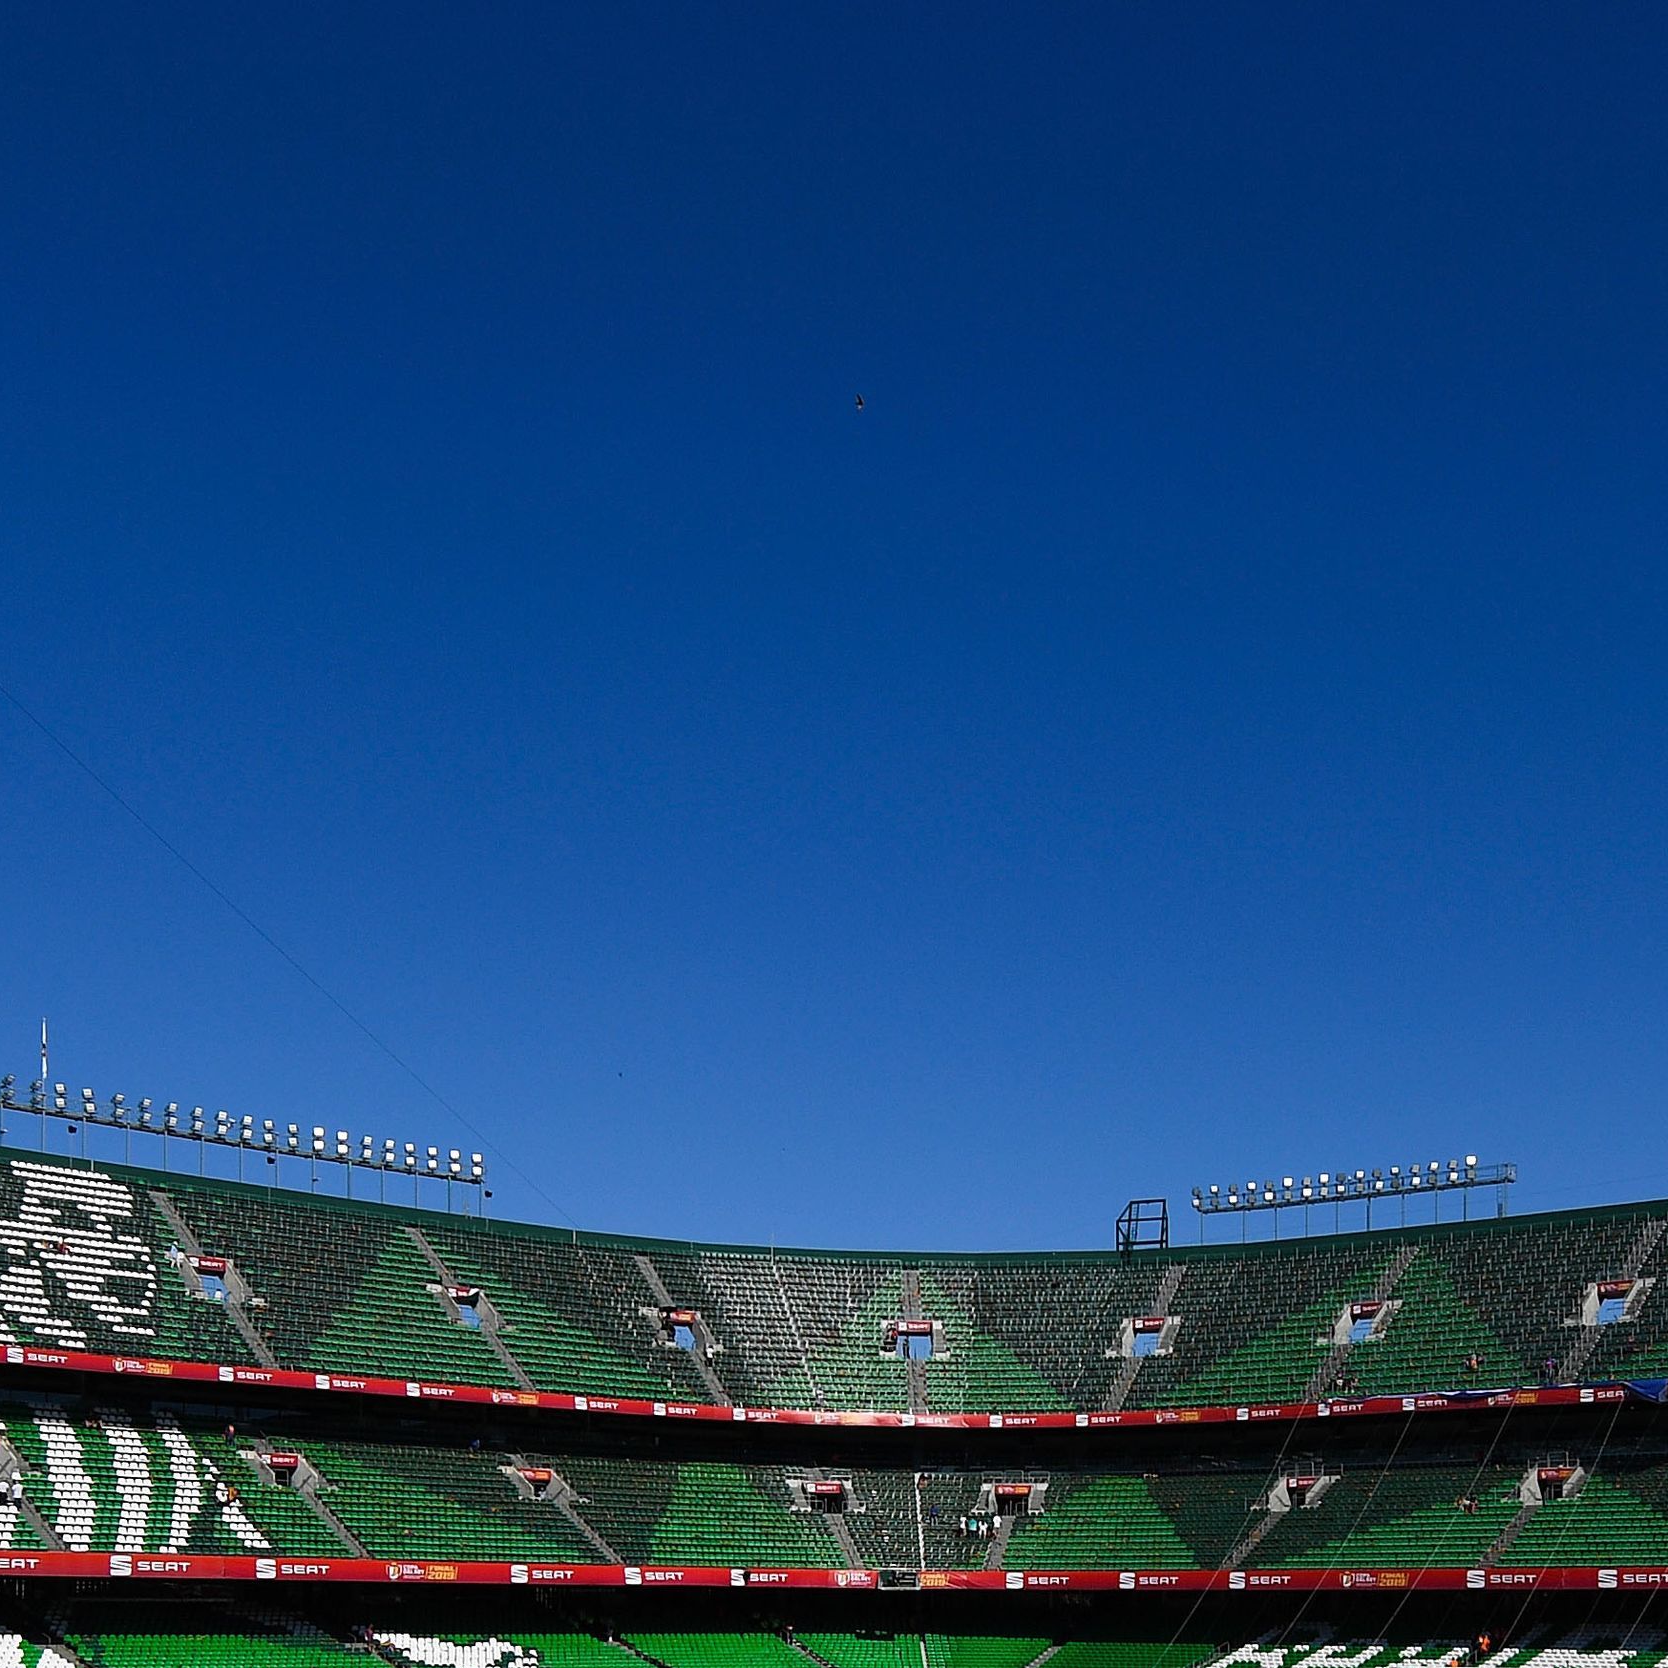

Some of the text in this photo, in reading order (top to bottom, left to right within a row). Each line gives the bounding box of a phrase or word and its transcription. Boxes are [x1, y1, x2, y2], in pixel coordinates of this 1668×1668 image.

[28, 1353, 67, 1363] SEAT
[237, 1372, 272, 1380] SEAT
[333, 1380, 366, 1388] SEAT
[1597, 1390, 1626, 1398] SEA
[1333, 1404, 1363, 1412] SEAT
[748, 1410, 779, 1419] SEAT
[138, 1562, 190, 1571] SEAT
[281, 1565, 329, 1574] SEAT
[427, 1571, 456, 1579] 2019
[532, 1570, 573, 1578] SEAT
[645, 1572, 683, 1580] SEAT
[1250, 1576, 1290, 1584] SEAT
[1490, 1575, 1536, 1583] SEAT
